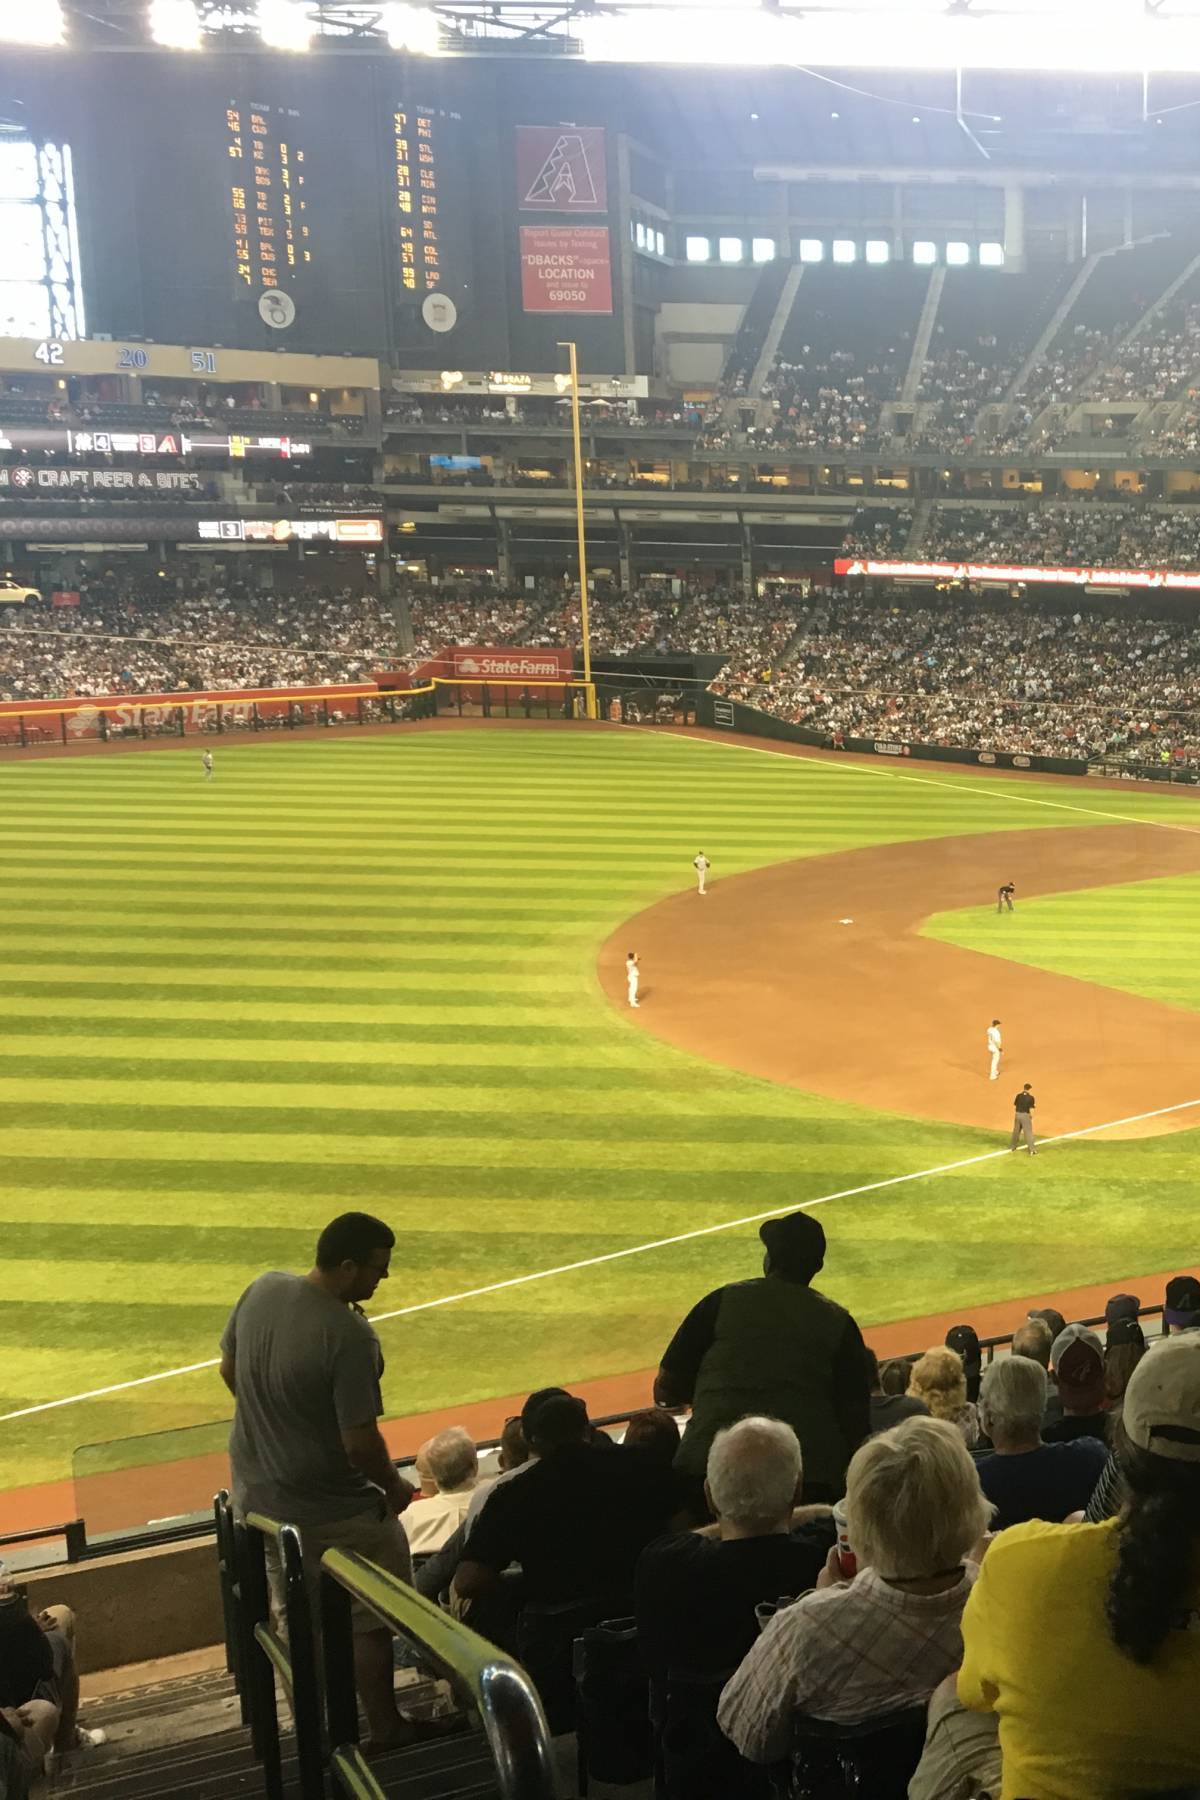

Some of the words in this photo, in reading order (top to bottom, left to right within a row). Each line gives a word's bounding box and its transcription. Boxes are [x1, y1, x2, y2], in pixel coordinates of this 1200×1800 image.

[226, 109, 240, 121] 54
[393, 112, 407, 125] 47
[416, 117, 432, 129] DET
[227, 121, 241, 132] 46
[394, 123, 402, 134] 2
[417, 127, 433, 139] PHI
[280, 143, 288, 154] 0
[395, 138, 408, 151] 39
[418, 143, 433, 155] STL
[228, 145, 243, 158] 57
[280, 154, 288, 165] 3
[297, 150, 305, 162] 2
[396, 150, 409, 162] 31
[281, 167, 289, 179] 3
[420, 168, 436, 180] CLE
[397, 175, 411, 187] 31
[231, 187, 245, 199] 55
[283, 192, 291, 205] 2
[284, 204, 292, 216] 3
[286, 228, 293, 241] 5
[399, 226, 413, 238] 64
[423, 229, 438, 241] ATL
[574, 230, 606, 238] Conduct
[287, 243, 295, 255] 0
[287, 253, 296, 266] 3
[303, 249, 312, 263] 3
[401, 251, 415, 264] 57
[424, 254, 440, 266] MIL
[538, 268, 595, 280] LOCATION
[549, 290, 586, 302] 69050
[35, 342, 64, 364] 42
[118, 348, 147, 369] 20
[191, 352, 217, 373] 51
[38, 470, 89, 486] CRAFT
[93, 471, 134, 487] BEER
[138, 473, 153, 487] &
[156, 472, 199, 489] BITES
